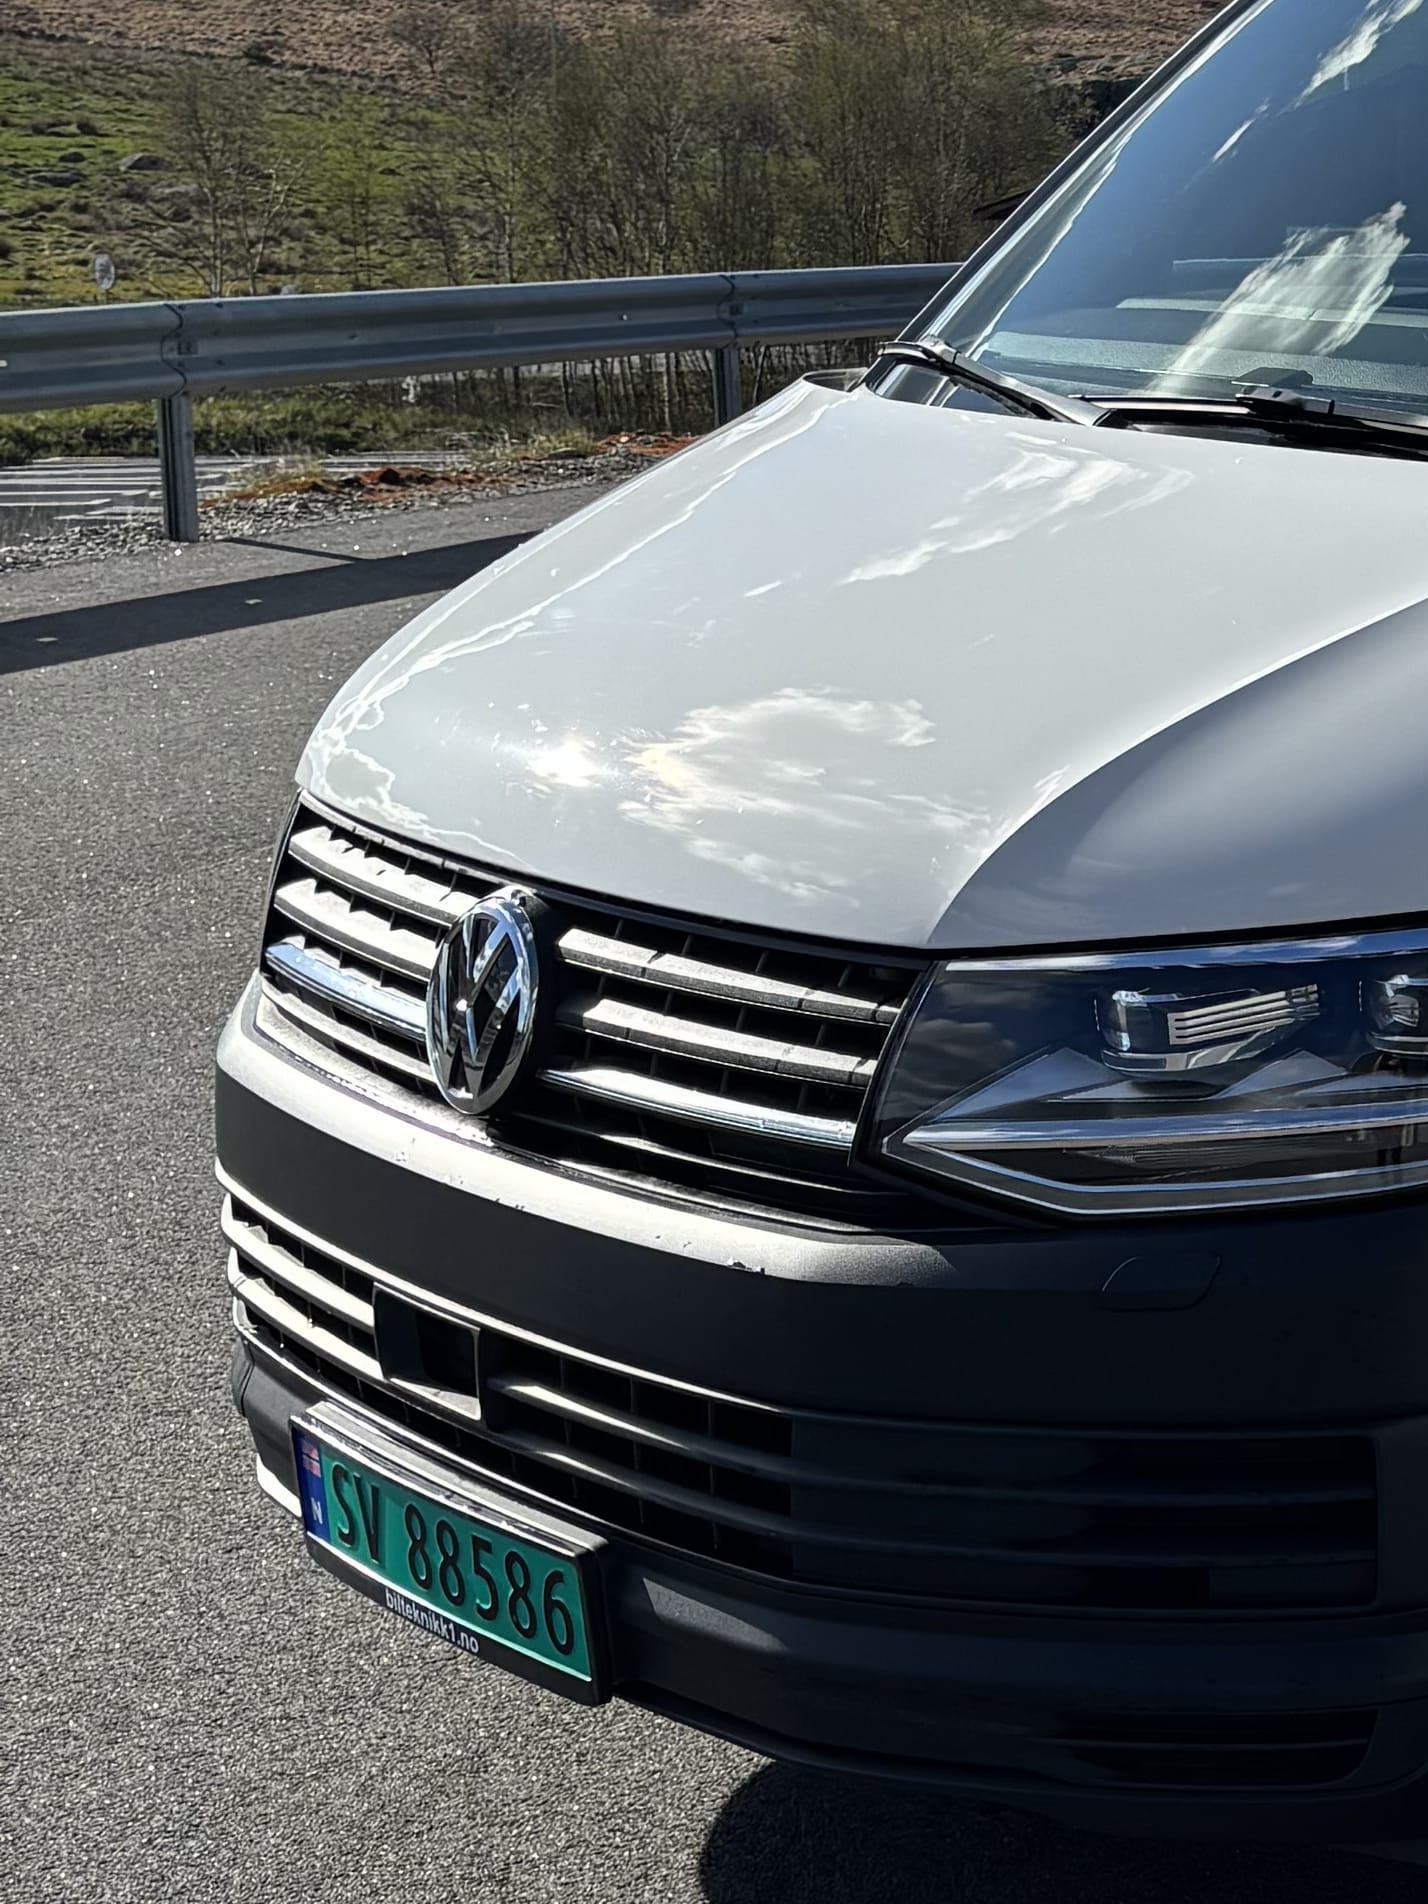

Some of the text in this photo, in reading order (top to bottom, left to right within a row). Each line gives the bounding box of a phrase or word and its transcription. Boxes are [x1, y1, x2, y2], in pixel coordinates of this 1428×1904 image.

[310, 1496, 324, 1525] N
[331, 1463, 575, 1656] SV 88586
